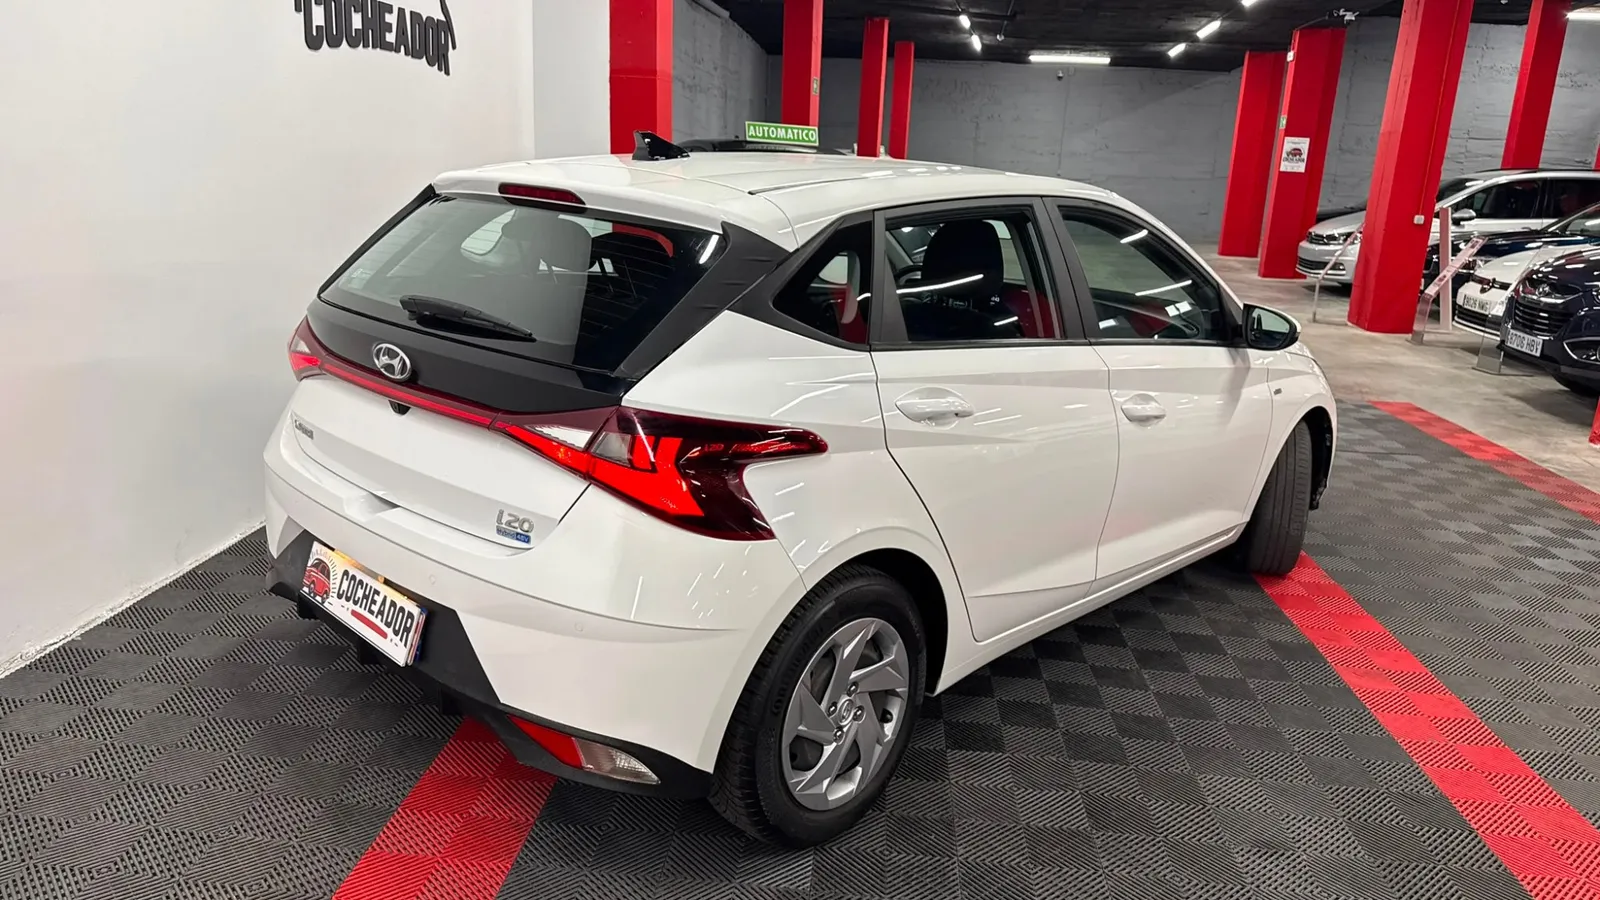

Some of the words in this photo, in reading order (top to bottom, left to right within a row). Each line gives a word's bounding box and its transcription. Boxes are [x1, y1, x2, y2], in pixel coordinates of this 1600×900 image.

[303, 0, 451, 76] COCHEADOR
[748, 125, 817, 141] AUTOMATICO
[336, 569, 416, 649] COCHEADOR
